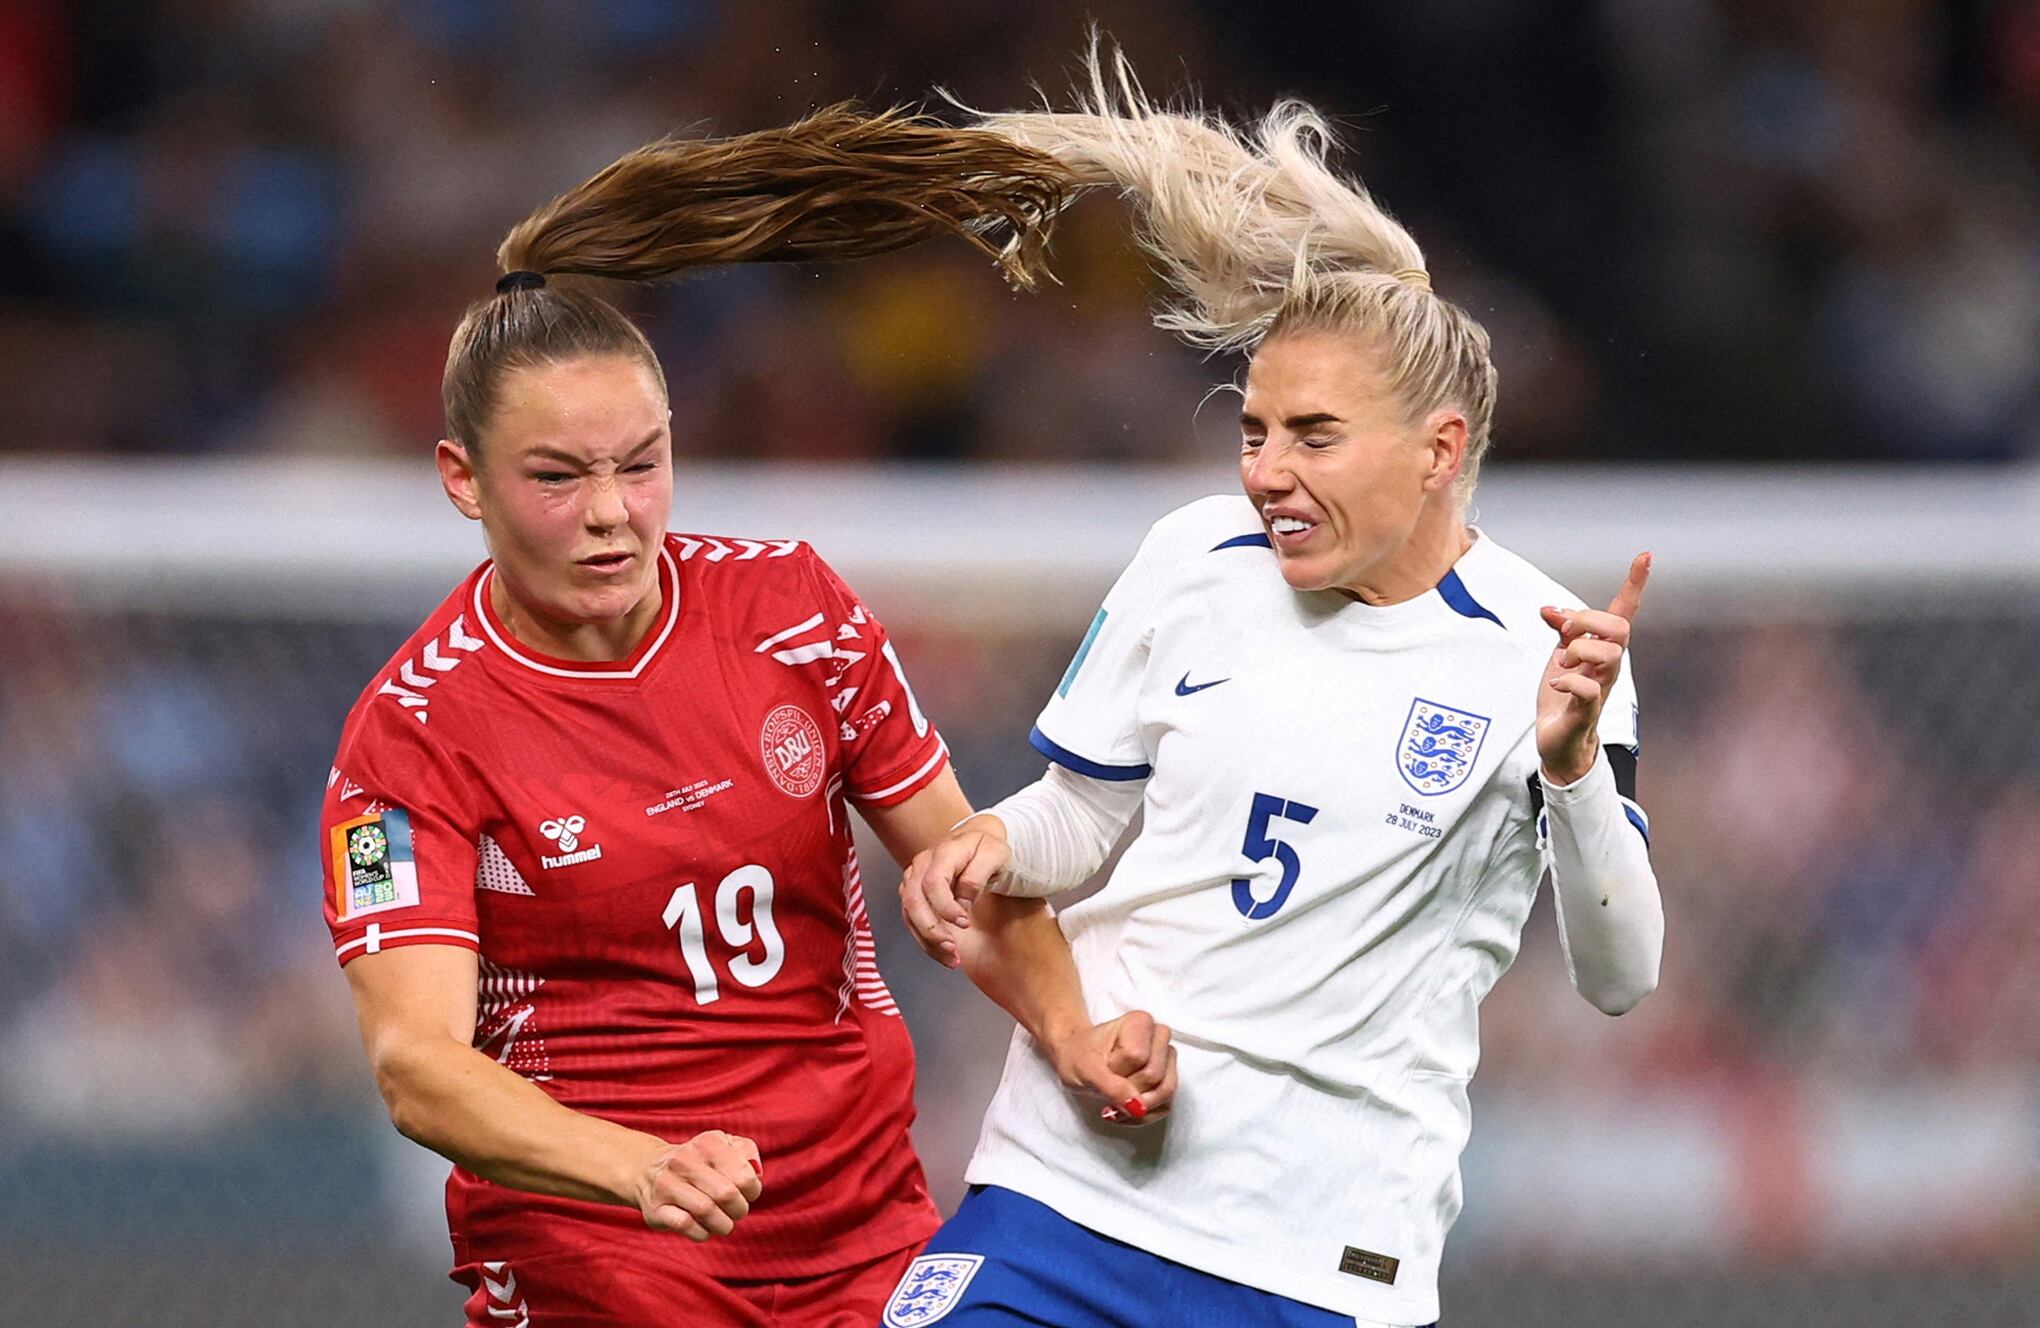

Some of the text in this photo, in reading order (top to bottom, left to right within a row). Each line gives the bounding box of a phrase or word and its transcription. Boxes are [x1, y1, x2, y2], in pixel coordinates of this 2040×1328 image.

[775, 729, 812, 771] DBU
[646, 797, 684, 816] ENGLAND
[695, 779, 734, 799] DENMARK
[682, 800, 705, 812] SYDNEY
[1385, 813, 1442, 838] 28 JULY 2023
[1400, 803, 1435, 823] DENMARK
[541, 843, 602, 870] hummel
[1231, 791, 1319, 920] 5
[353, 868, 366, 877] FIFA
[661, 864, 785, 1006] 19
